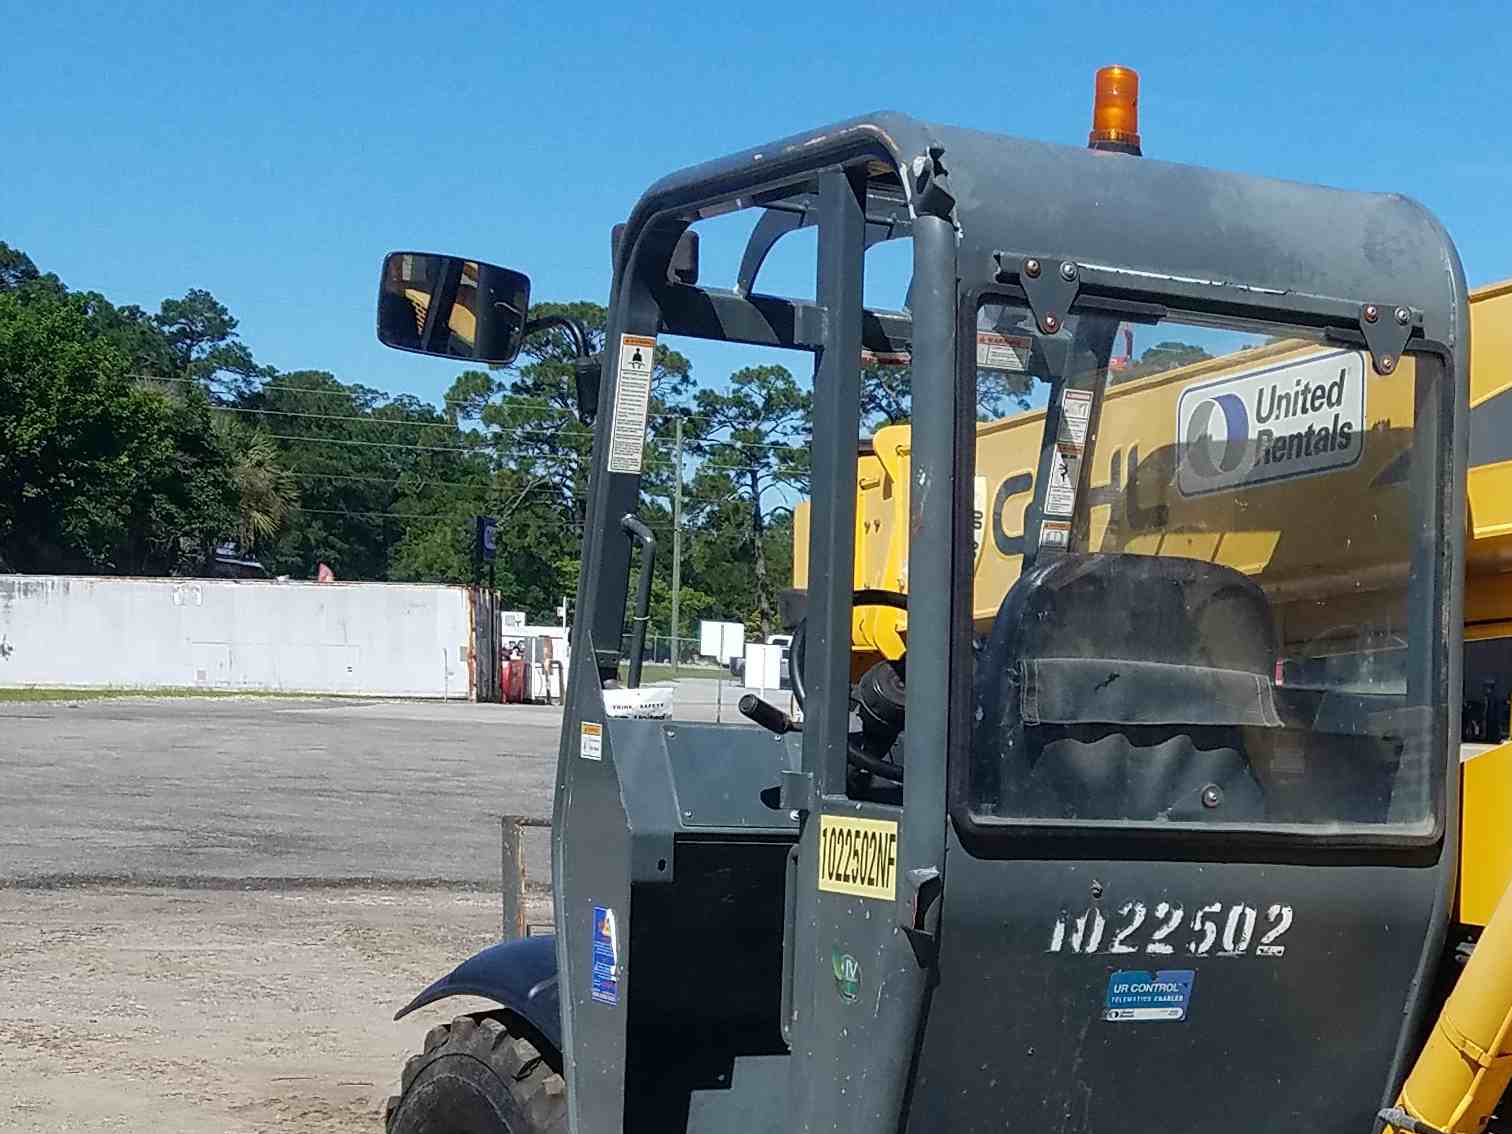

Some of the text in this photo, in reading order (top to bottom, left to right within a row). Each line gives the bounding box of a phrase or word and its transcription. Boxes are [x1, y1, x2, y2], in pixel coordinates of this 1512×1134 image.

[1256, 368, 1346, 424] United
[1254, 413, 1353, 467] Rentals
[822, 827, 896, 888] 1022502NF
[1045, 902, 1294, 957] 1022502
[1113, 983, 1129, 994] UR
